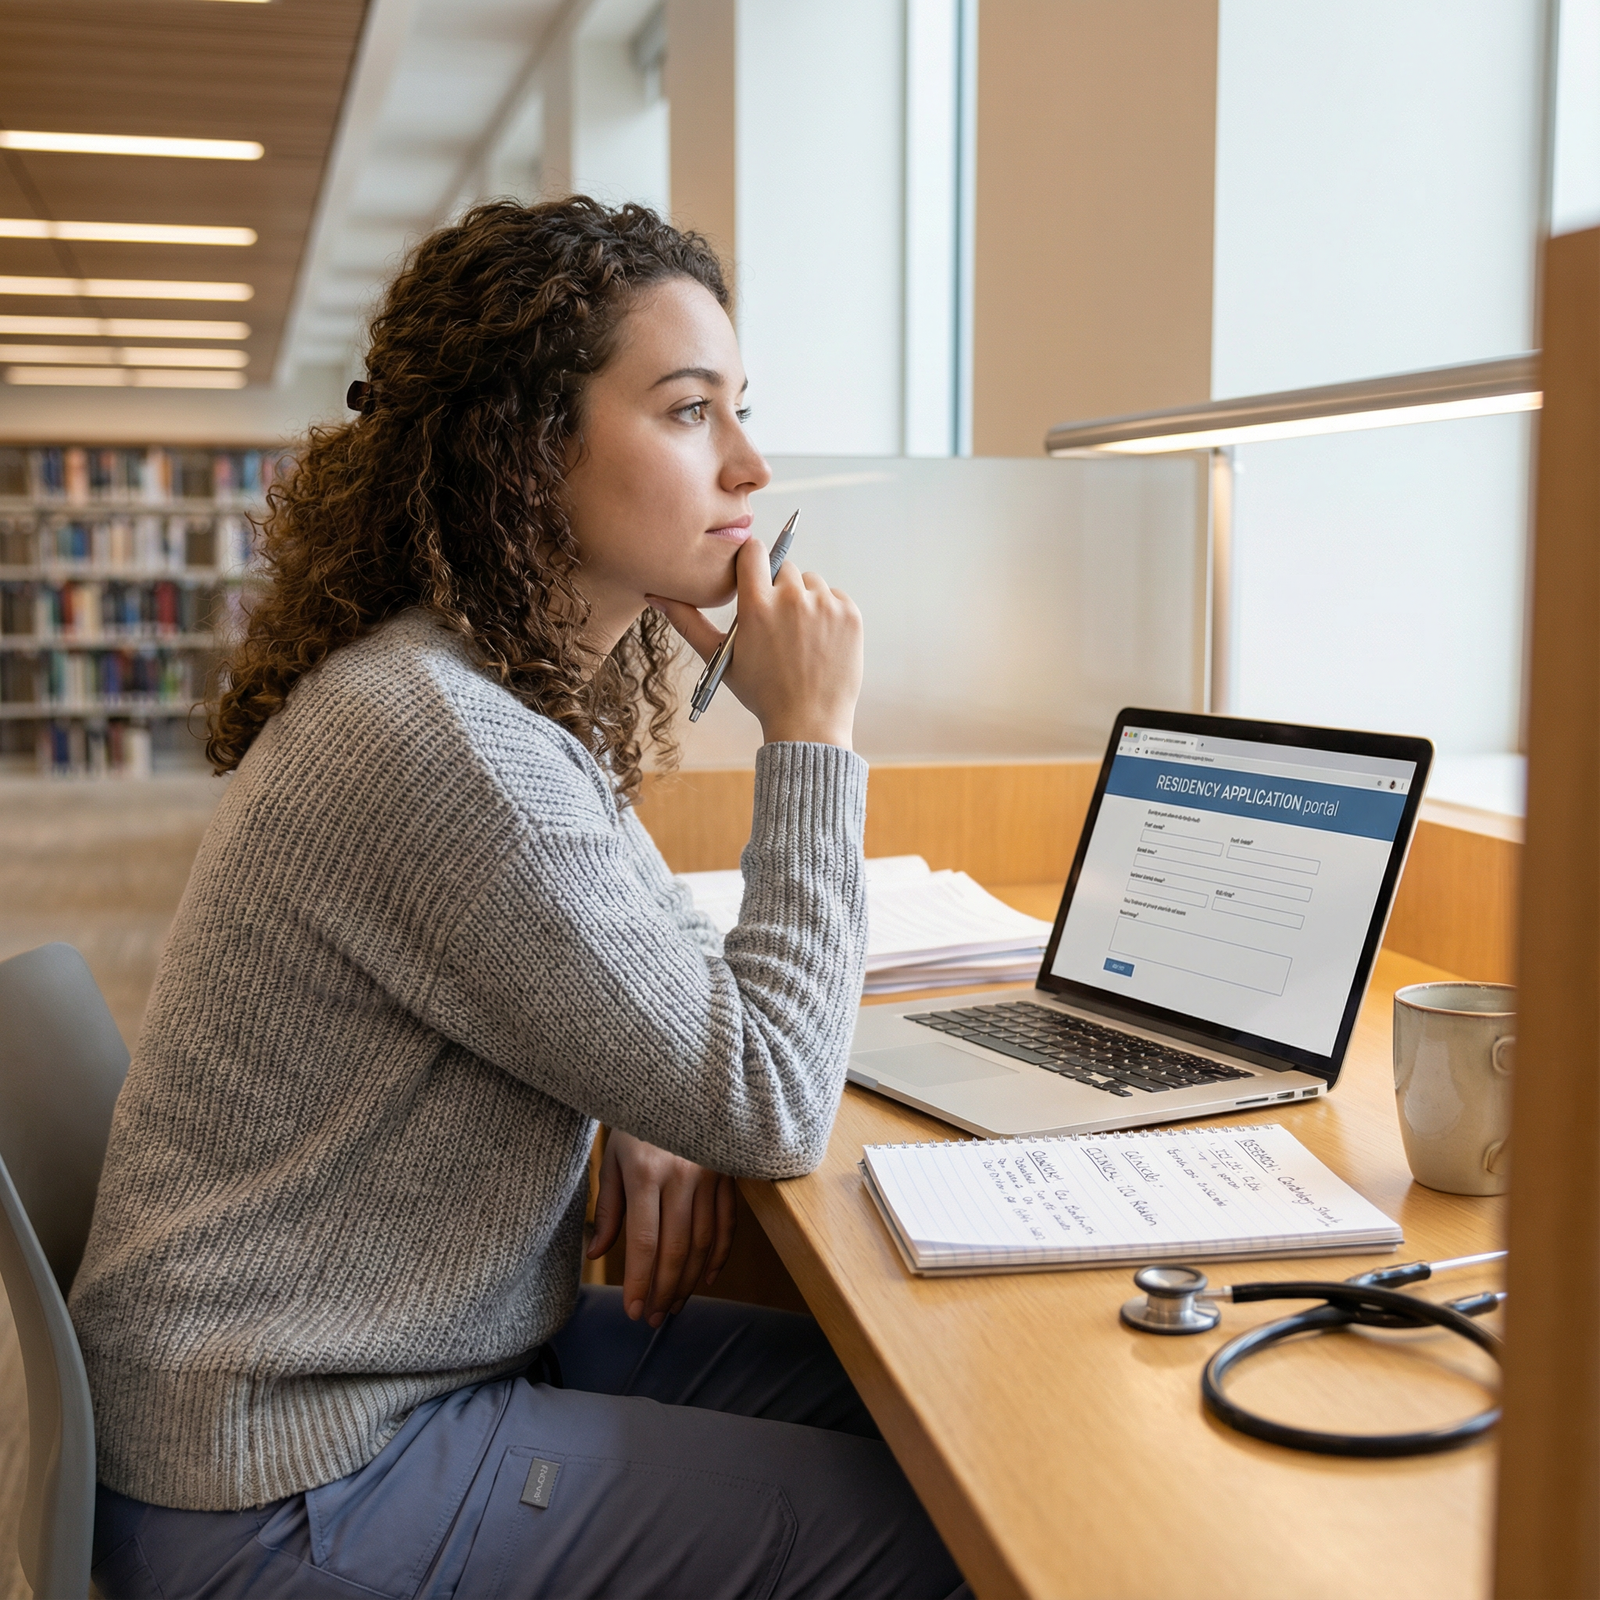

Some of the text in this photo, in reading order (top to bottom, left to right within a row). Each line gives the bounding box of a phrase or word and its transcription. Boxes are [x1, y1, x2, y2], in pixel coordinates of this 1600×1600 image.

[1156, 774, 1340, 817] RESIDENCY APPLICATION portal
